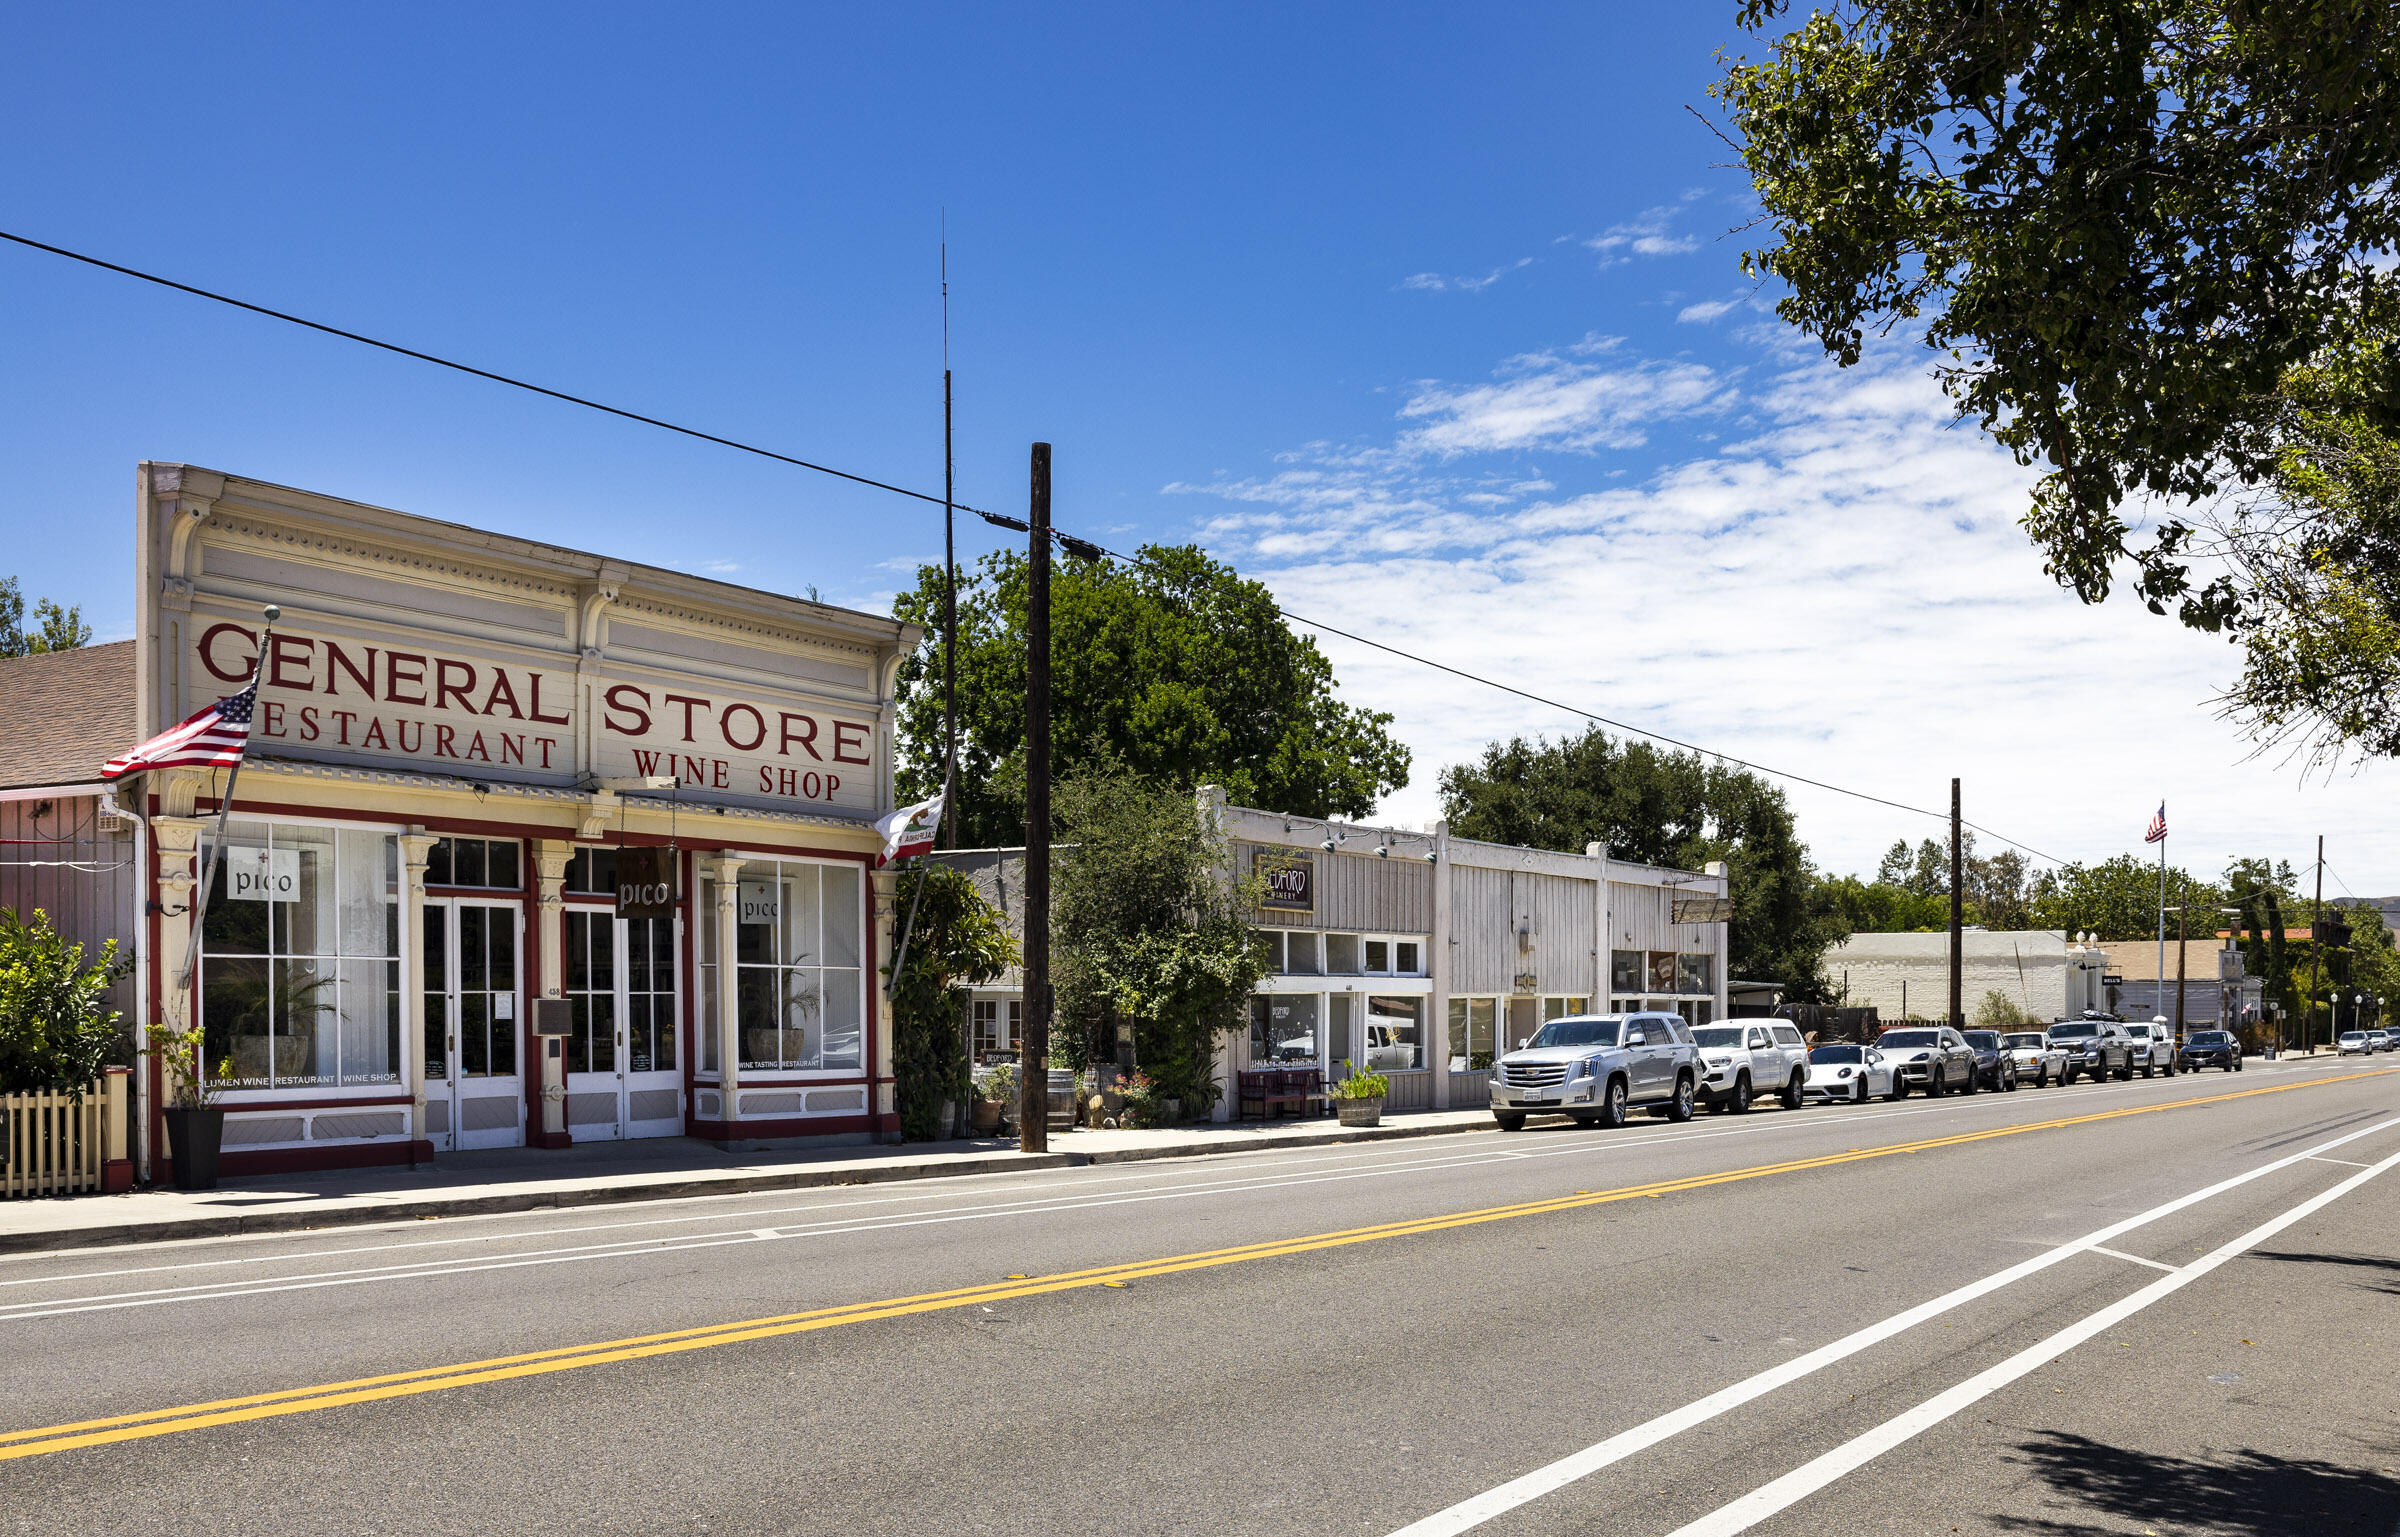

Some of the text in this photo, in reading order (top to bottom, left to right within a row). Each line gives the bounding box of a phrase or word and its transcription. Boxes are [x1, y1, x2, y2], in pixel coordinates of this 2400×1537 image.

[196, 623, 871, 766] GENERAL STORE
[217, 696, 557, 769] ESTAURANT
[632, 749, 841, 802] WINE SHOP
[236, 872, 292, 895] pico
[620, 883, 669, 911] pico
[781, 1060, 819, 1068] RESTAURANT
[242, 1077, 270, 1086] WINE
[275, 1075, 335, 1085] RESTAURANT
[343, 1074, 369, 1082] WINE
[370, 1073, 397, 1082] SHOP
